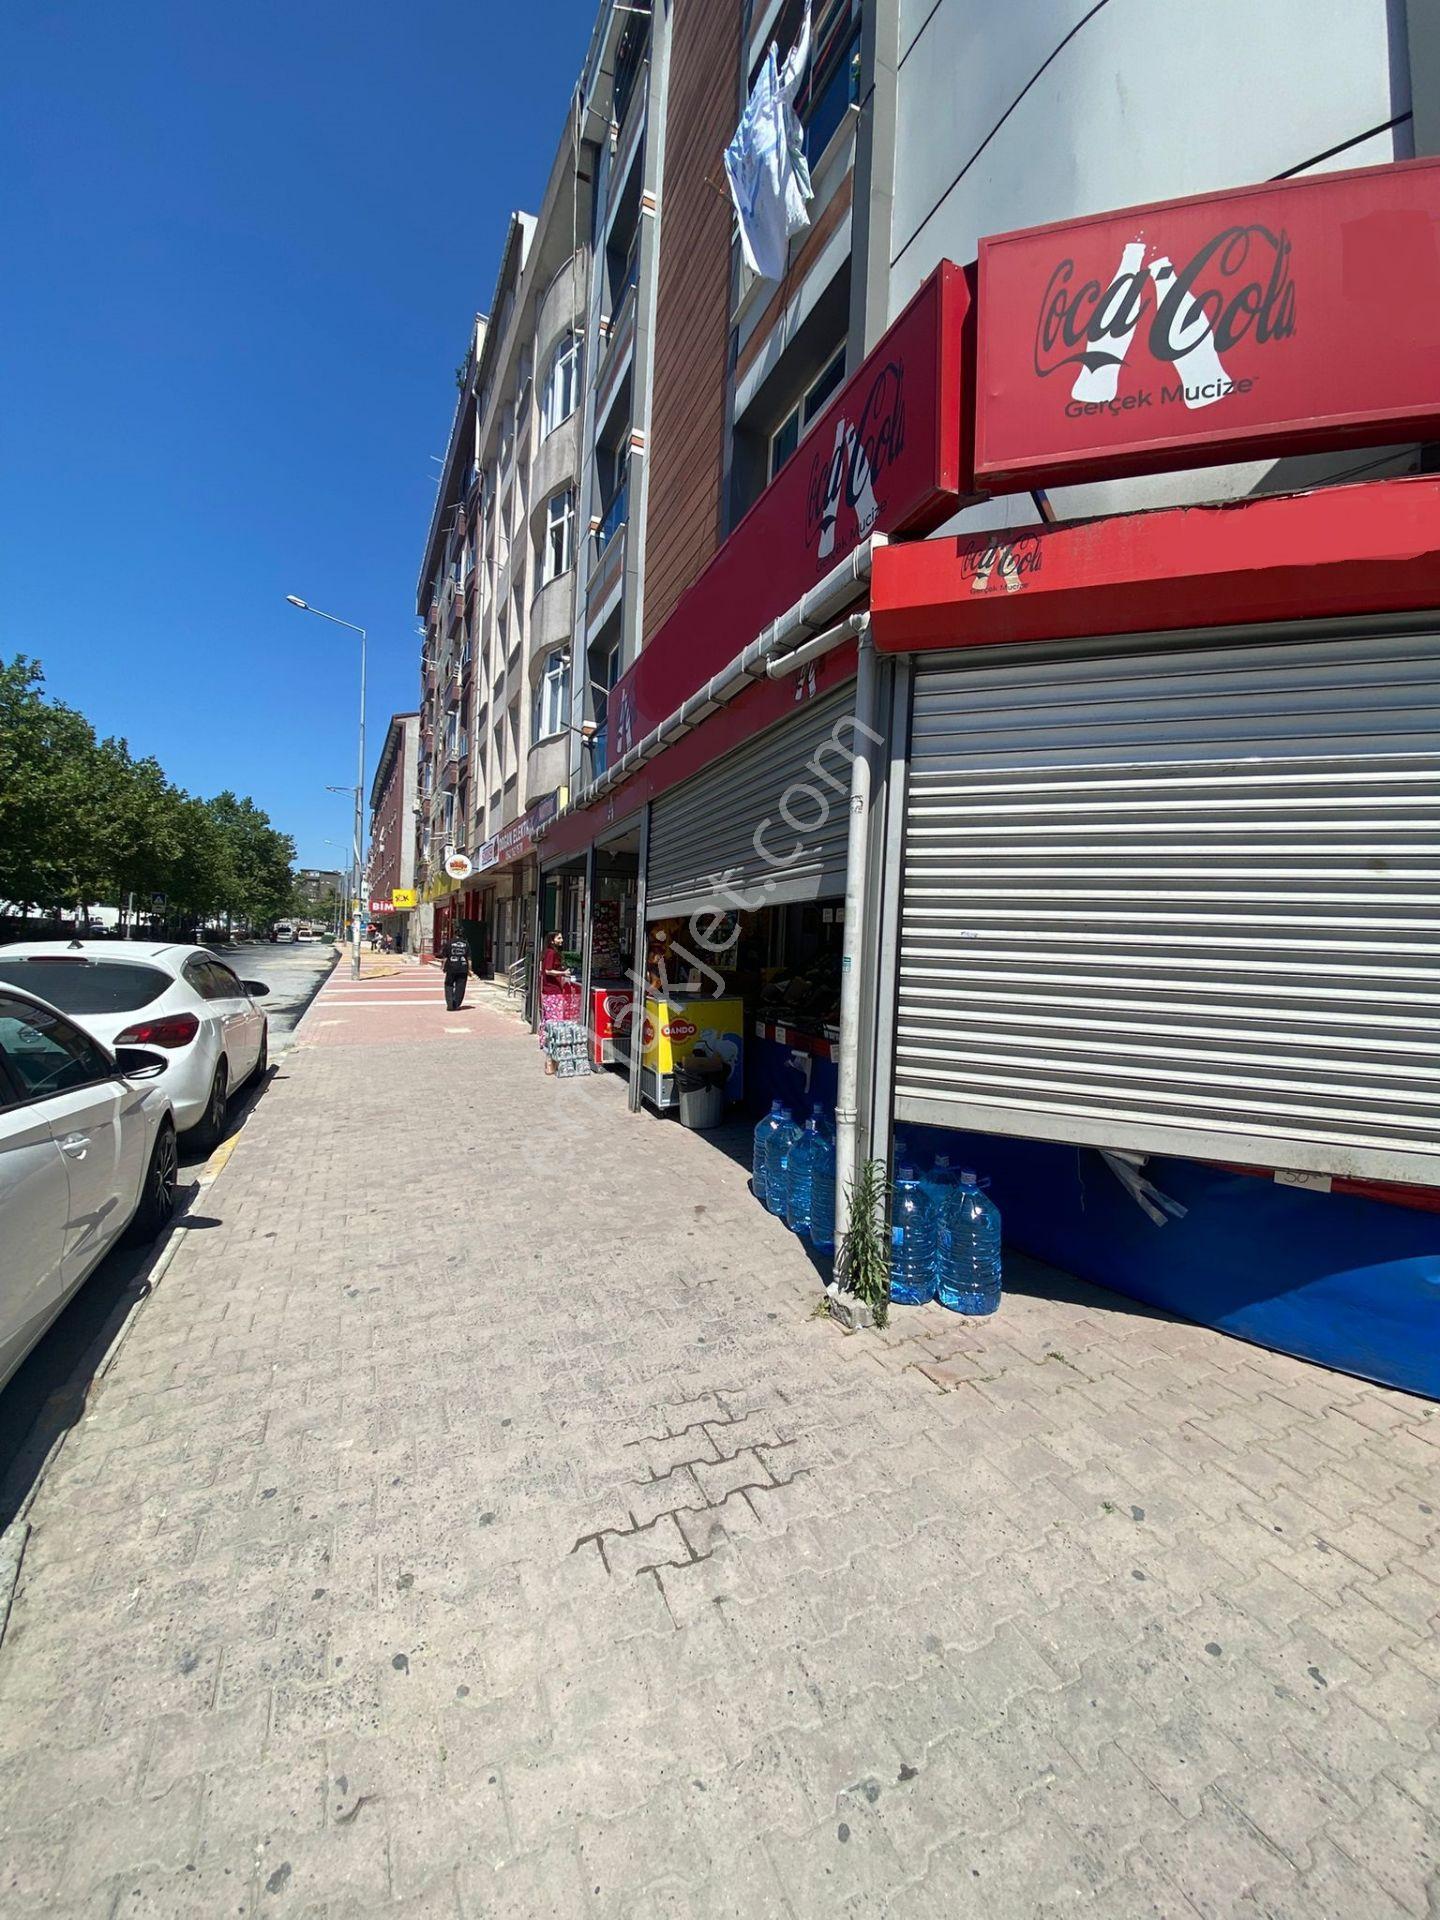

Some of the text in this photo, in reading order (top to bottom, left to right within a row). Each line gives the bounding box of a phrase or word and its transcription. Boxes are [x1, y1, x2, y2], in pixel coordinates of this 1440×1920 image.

[1033, 223, 1296, 378] Coca-Cola
[1064, 377, 1253, 418] Gerçek Mucize
[372, 900, 395, 911] BİM
